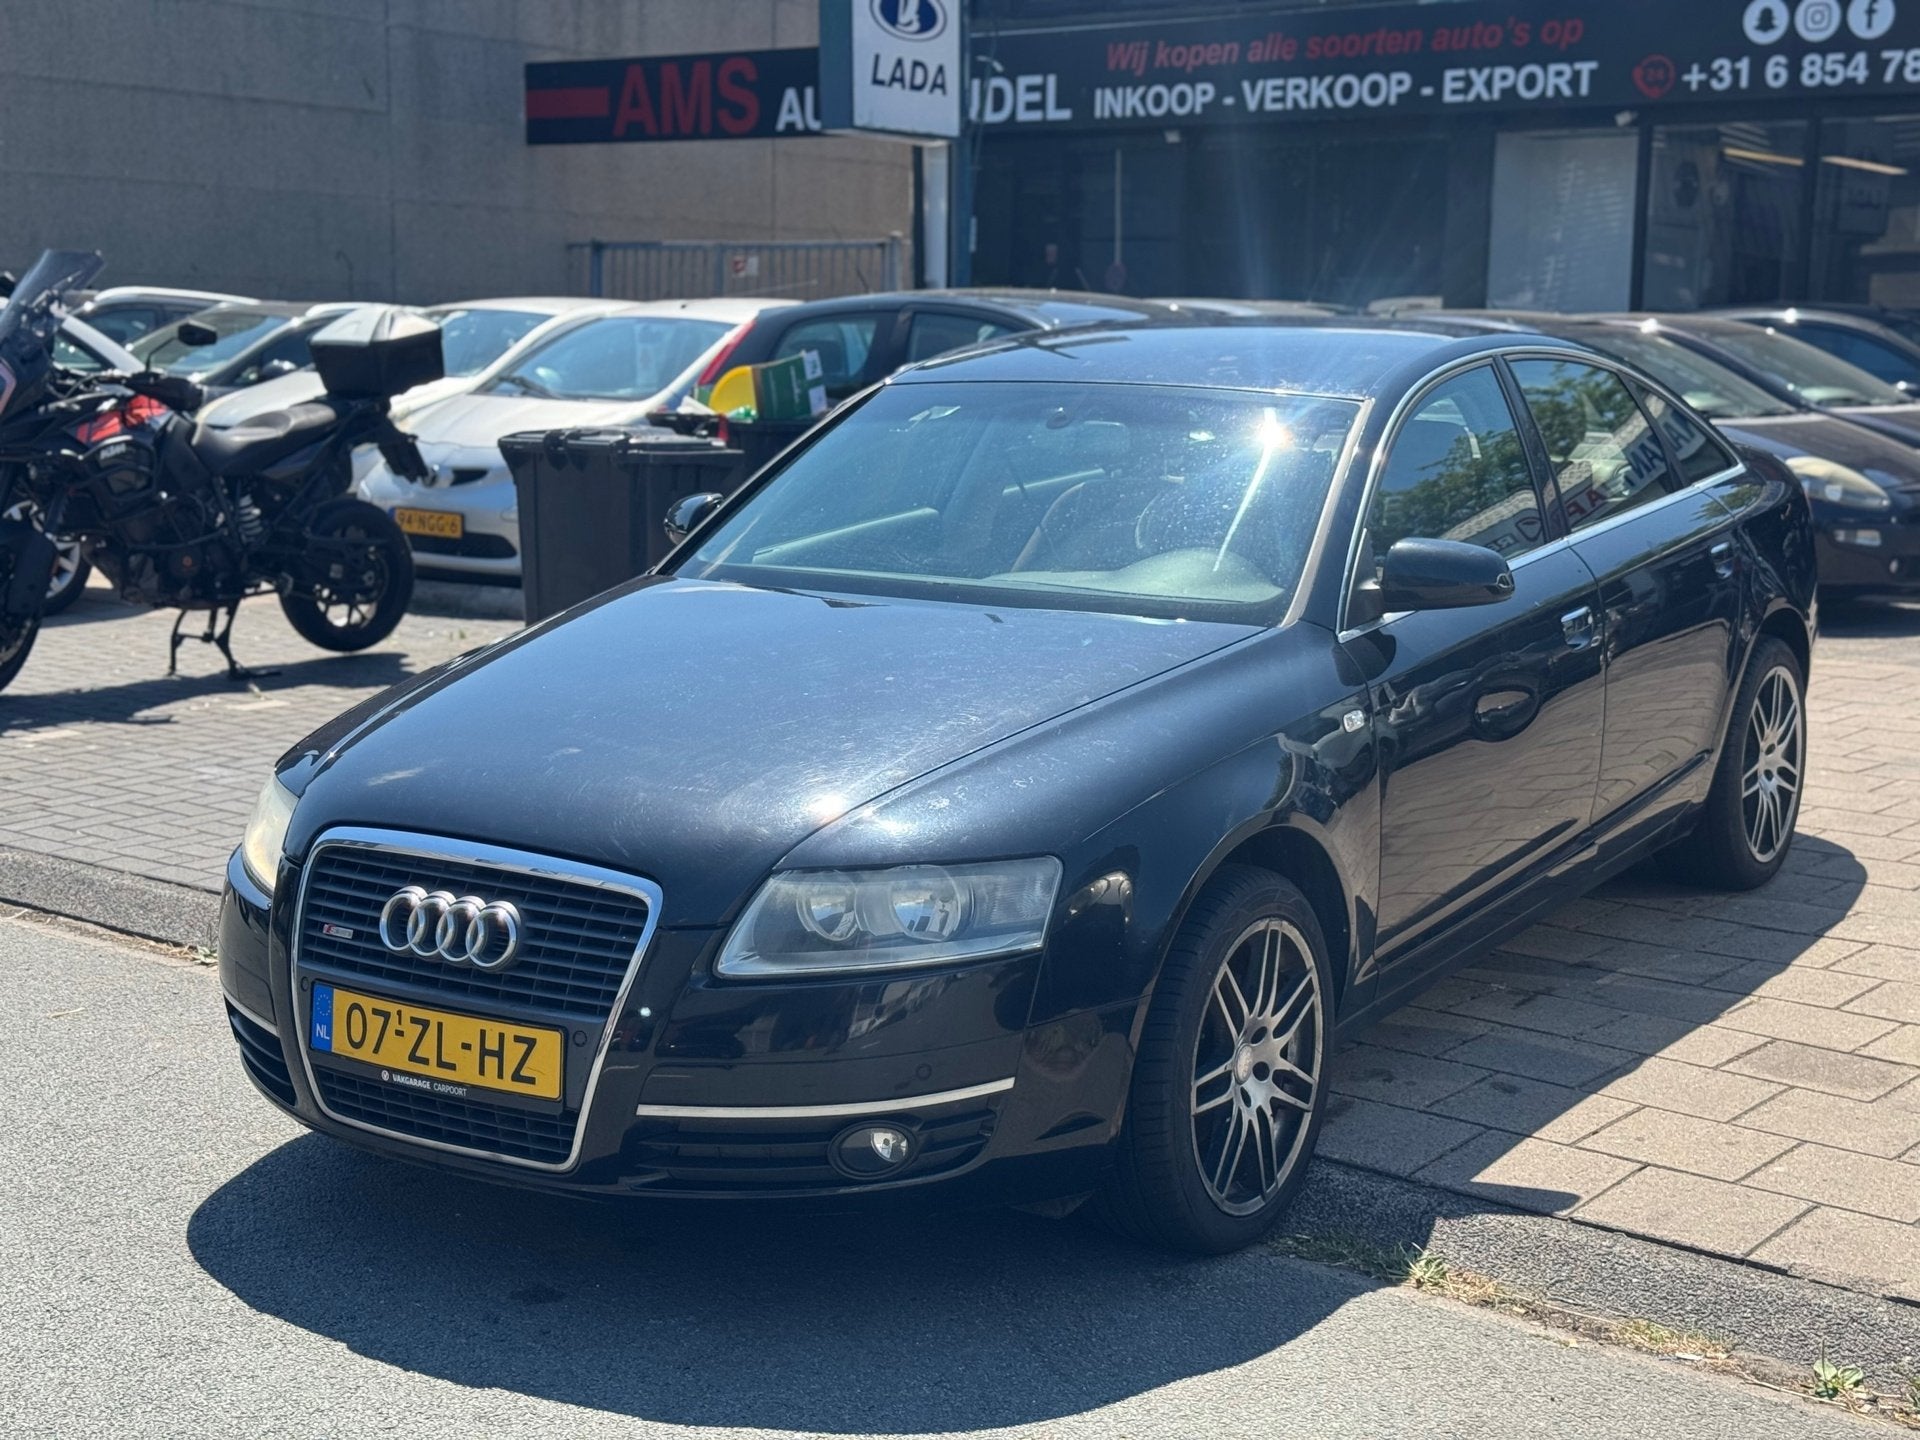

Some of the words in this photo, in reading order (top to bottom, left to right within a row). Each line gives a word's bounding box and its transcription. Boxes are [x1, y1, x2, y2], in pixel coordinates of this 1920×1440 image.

[1107, 41, 1148, 76] Wij
[1154, 40, 1240, 72] kopen
[1247, 32, 1297, 63] alle
[1305, 27, 1423, 59] soorten
[1431, 17, 1531, 50] auto's
[1539, 17, 1585, 51] op
[871, 53, 946, 96] LADA
[1093, 82, 1215, 119] INKOOP
[1240, 71, 1412, 113] VERKOOP
[1442, 60, 1599, 103] EXPORT
[1681, 56, 1750, 91] +31
[1764, 55, 1789, 88] 6
[1799, 51, 1868, 87] 854
[612, 56, 760, 137] AMS
[315, 1023, 331, 1041] NL
[392, 1073, 431, 1089] VAKGARAGE
[433, 1082, 468, 1097] CARPOORT
